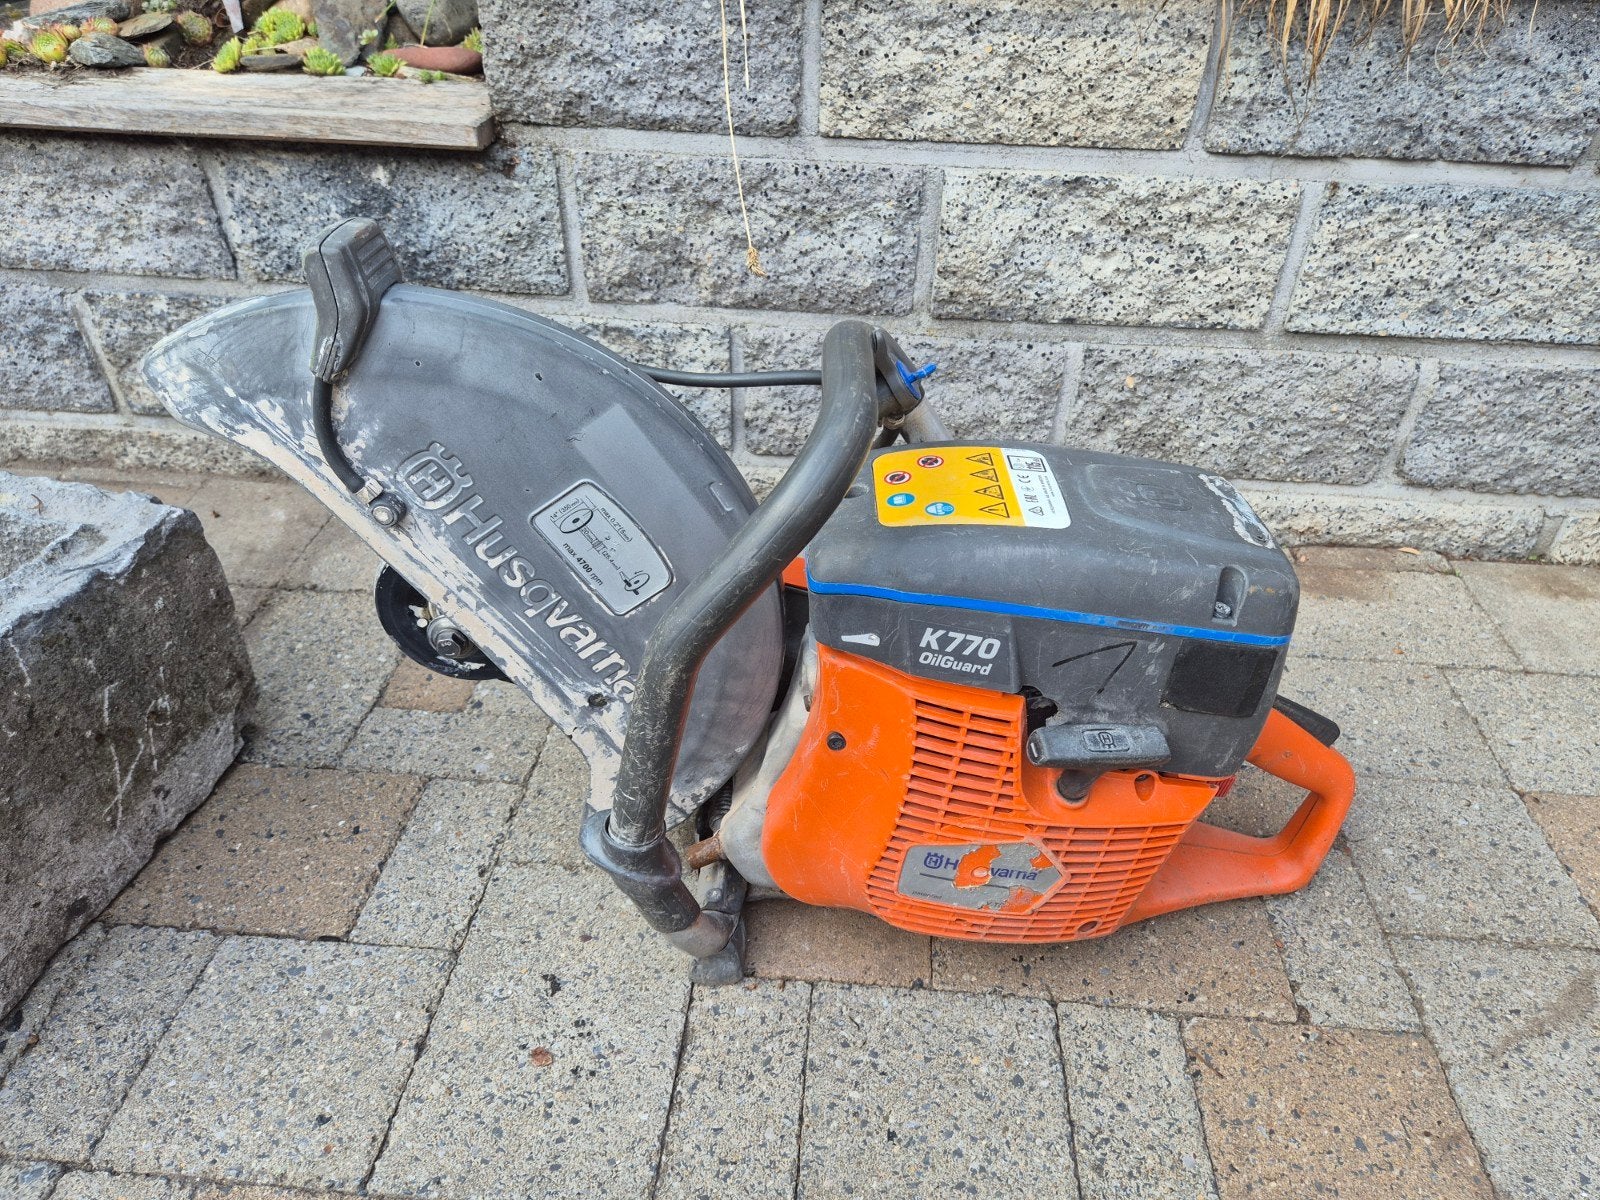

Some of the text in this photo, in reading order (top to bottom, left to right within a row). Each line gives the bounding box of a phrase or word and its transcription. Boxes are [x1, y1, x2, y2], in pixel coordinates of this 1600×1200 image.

[600, 507, 611, 518] max
[562, 542, 604, 586] max 4700 rpm
[918, 651, 993, 676] OilGuard
